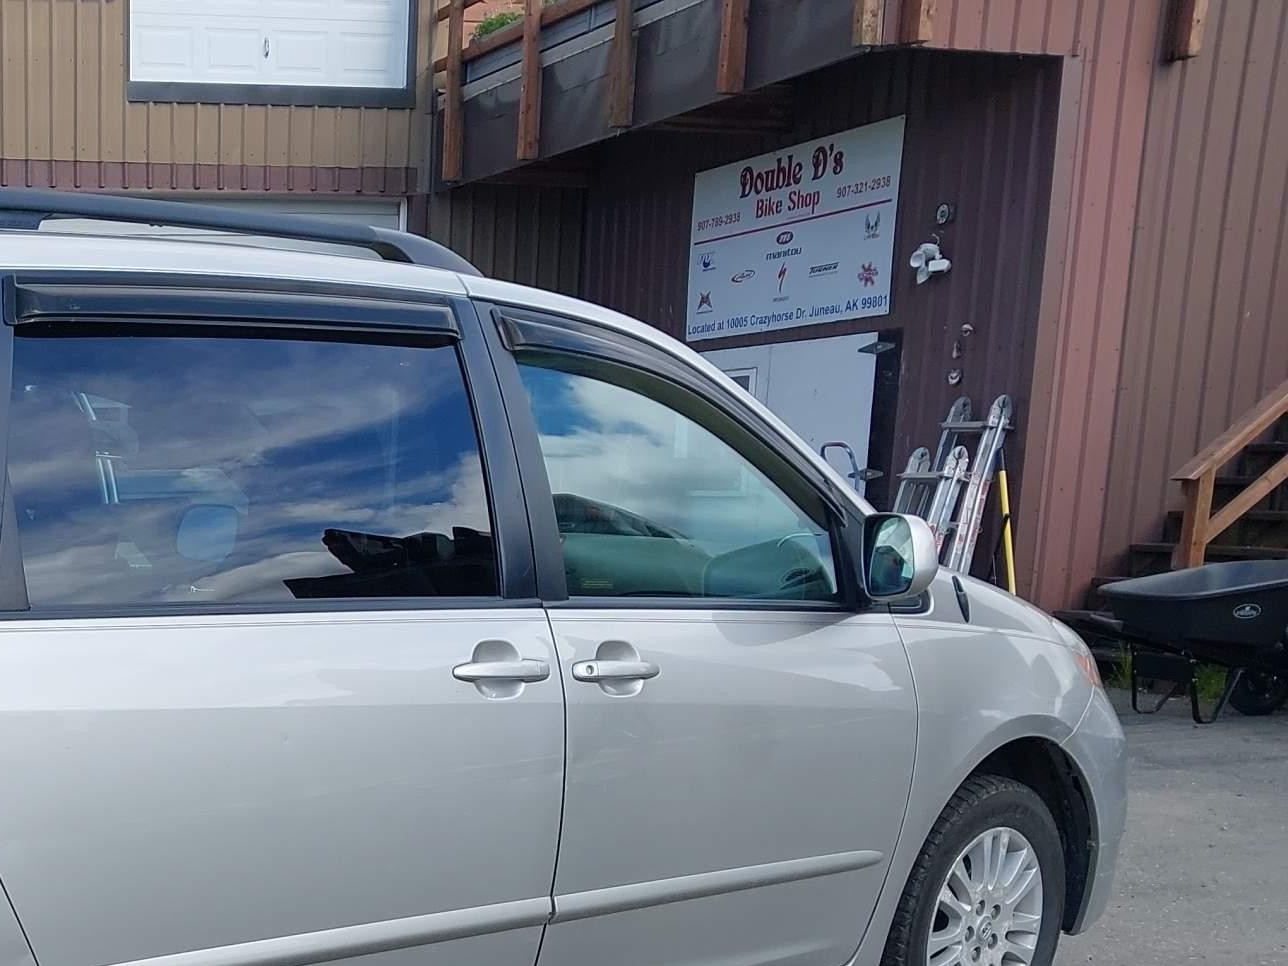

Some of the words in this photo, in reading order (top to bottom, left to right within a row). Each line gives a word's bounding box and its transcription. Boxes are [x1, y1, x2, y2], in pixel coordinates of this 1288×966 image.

[740, 154, 803, 199] Double
[812, 143, 844, 181] D's
[836, 175, 891, 199] 907-321-2938
[756, 196, 782, 218] Bike
[788, 190, 821, 215] Shop
[765, 247, 802, 261] manitou
[687, 321, 716, 335] Located
[717, 321, 724, 330] at
[727, 317, 748, 329] 10005
[751, 310, 794, 327] Crazyhorse
[796, 307, 807, 320] Dr.
[809, 304, 843, 318] Juneau,
[844, 298, 859, 313] AK
[861, 294, 888, 310] 99801
